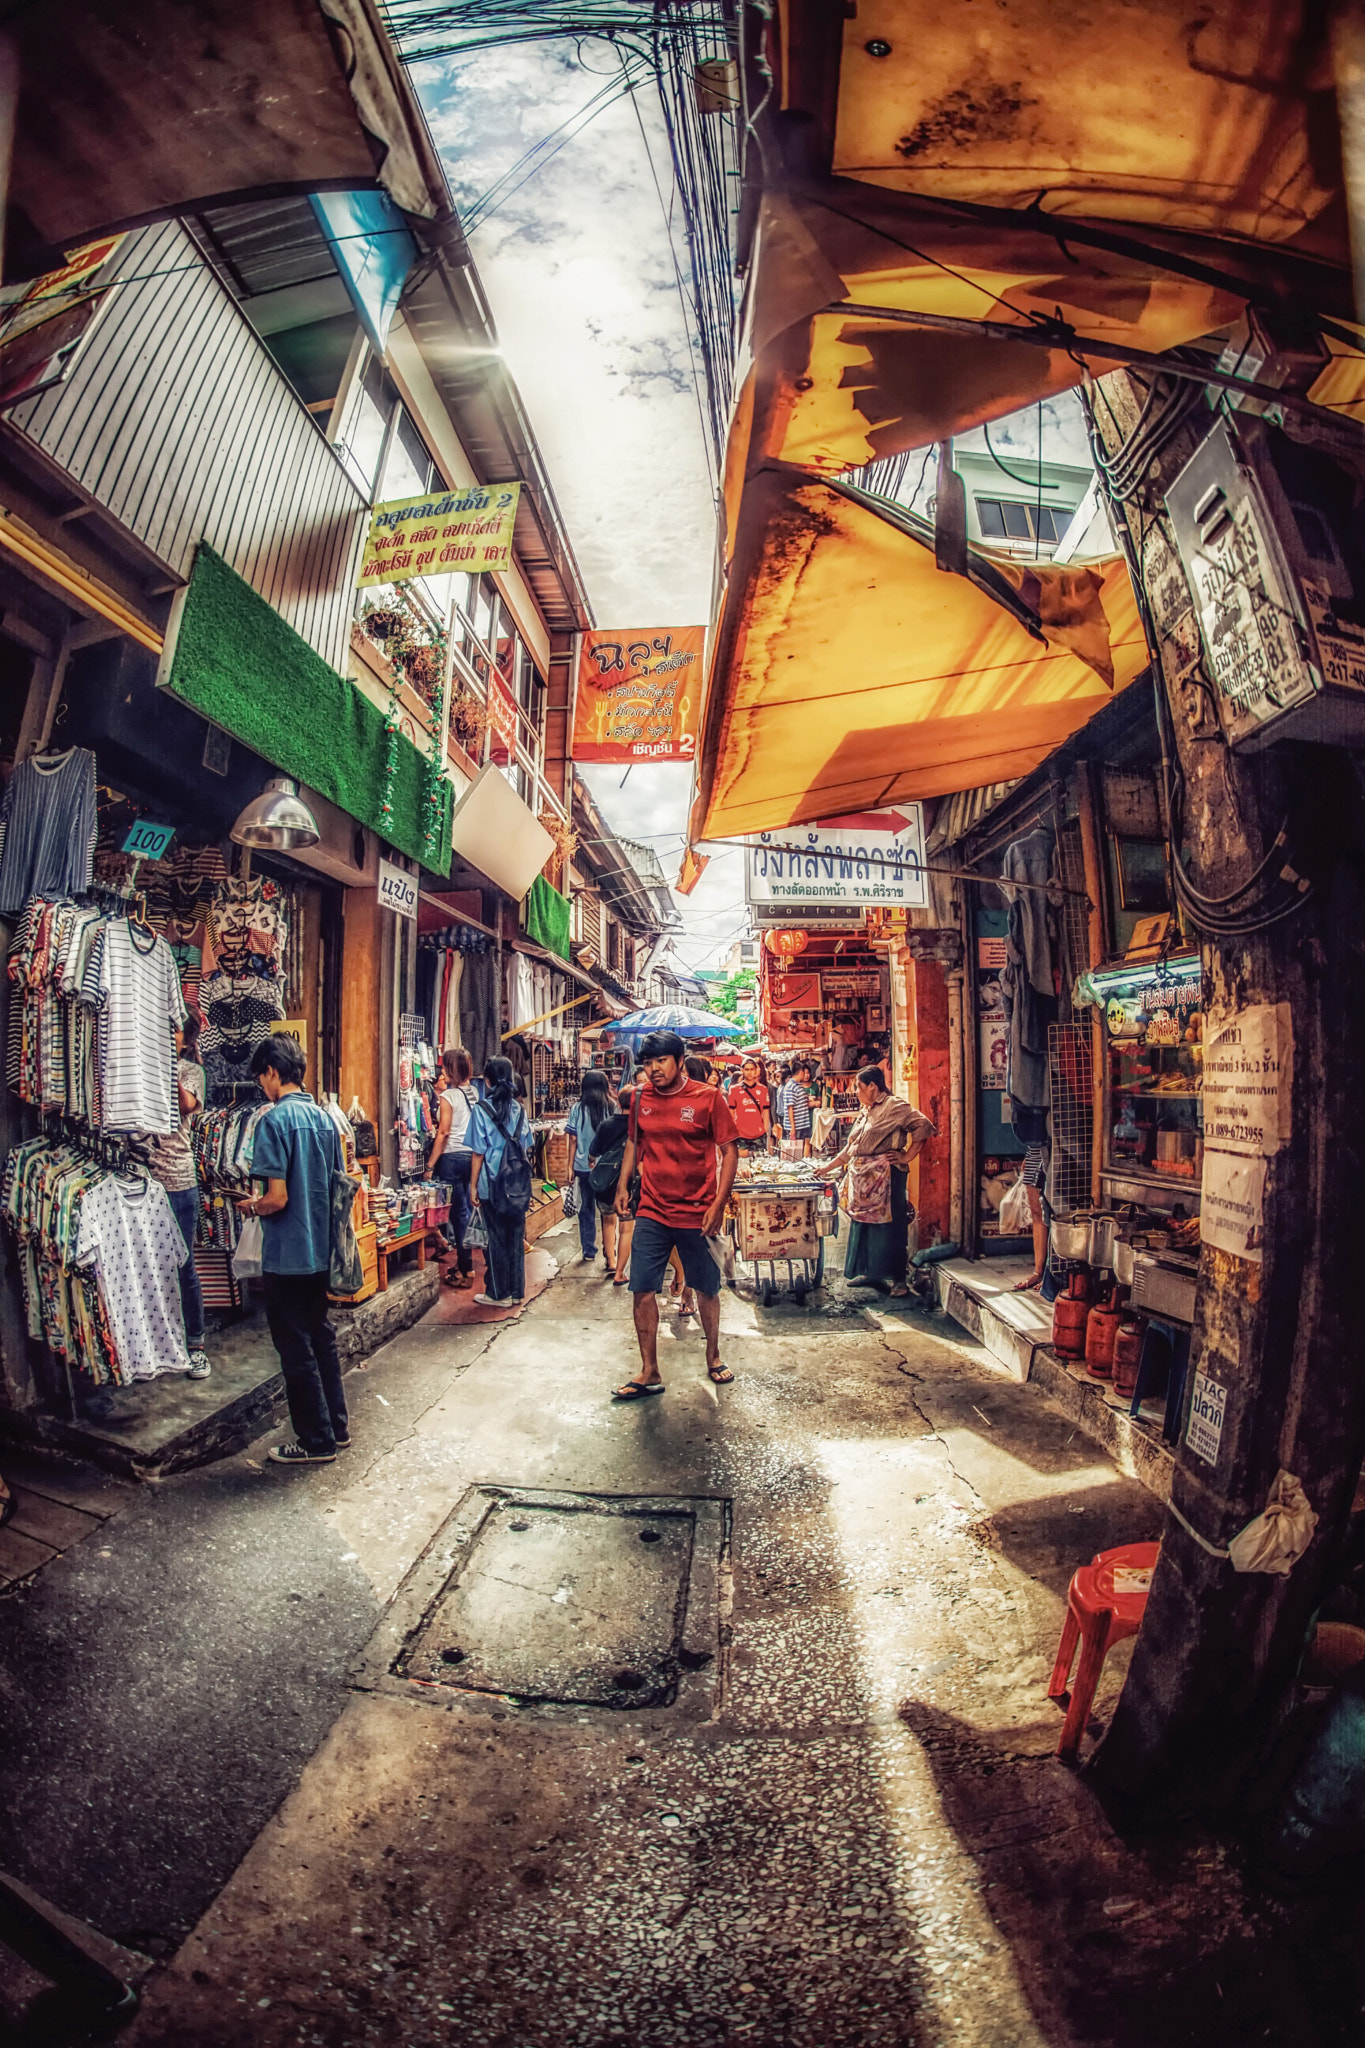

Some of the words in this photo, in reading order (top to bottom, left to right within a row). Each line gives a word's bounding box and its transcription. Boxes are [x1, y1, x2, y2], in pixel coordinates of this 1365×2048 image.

[497, 493, 512, 508] 2
[409, 526, 438, 544] สลัด
[439, 541, 476, 562] ต้มยำ
[614, 723, 643, 737] สลัด
[633, 739, 673, 756] เชิญชั้น
[679, 733, 694, 753] 2
[130, 828, 166, 852] 100
[753, 832, 920, 882] วังหลังพลาซ่า
[771, 882, 846, 897] ทางลัดออกหน้า
[853, 883, 904, 898] ร.พ.ศิริราช
[768, 903, 852, 915] Coffee
[1203, 1378, 1225, 1402] TAC
[1193, 1390, 1222, 1428] ปลวก
